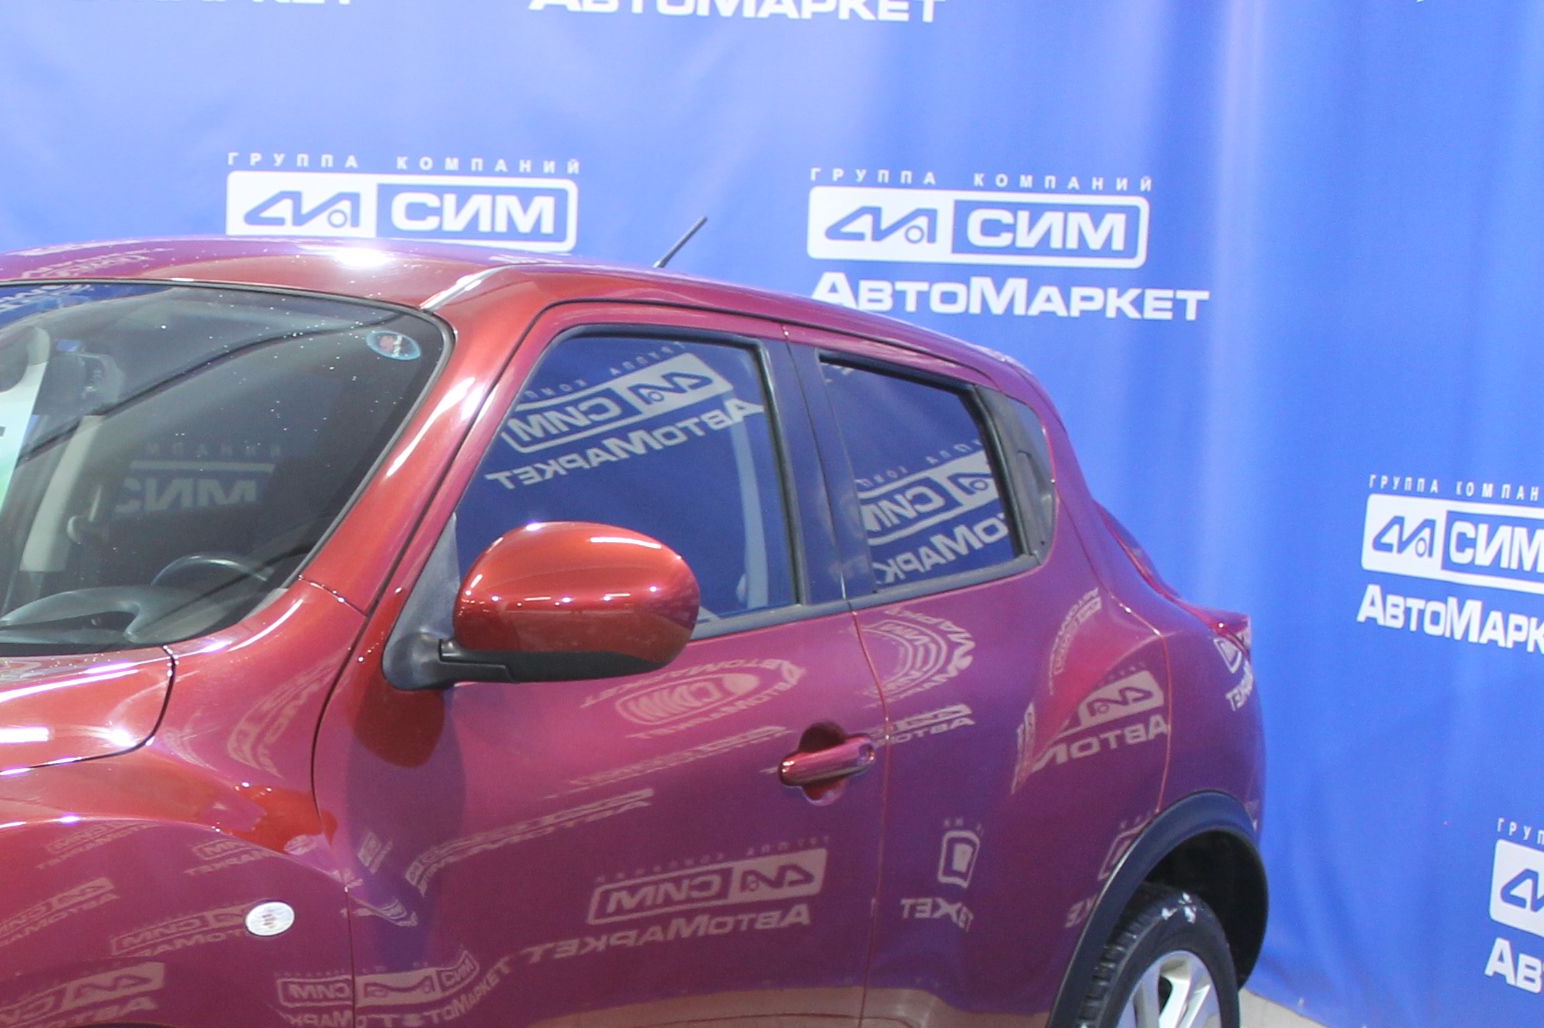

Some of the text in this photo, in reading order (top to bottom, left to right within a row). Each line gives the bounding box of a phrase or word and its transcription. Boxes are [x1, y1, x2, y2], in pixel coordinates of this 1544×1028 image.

[228, 152, 581, 174] ГРУППА КОМПАНИЙ
[810, 168, 1153, 192] ГРУППА КОМПАНИЙ
[391, 192, 554, 234] СИМ
[967, 209, 1126, 252] СИМ
[1369, 474, 1544, 502] ГРУППА КОМПАН
